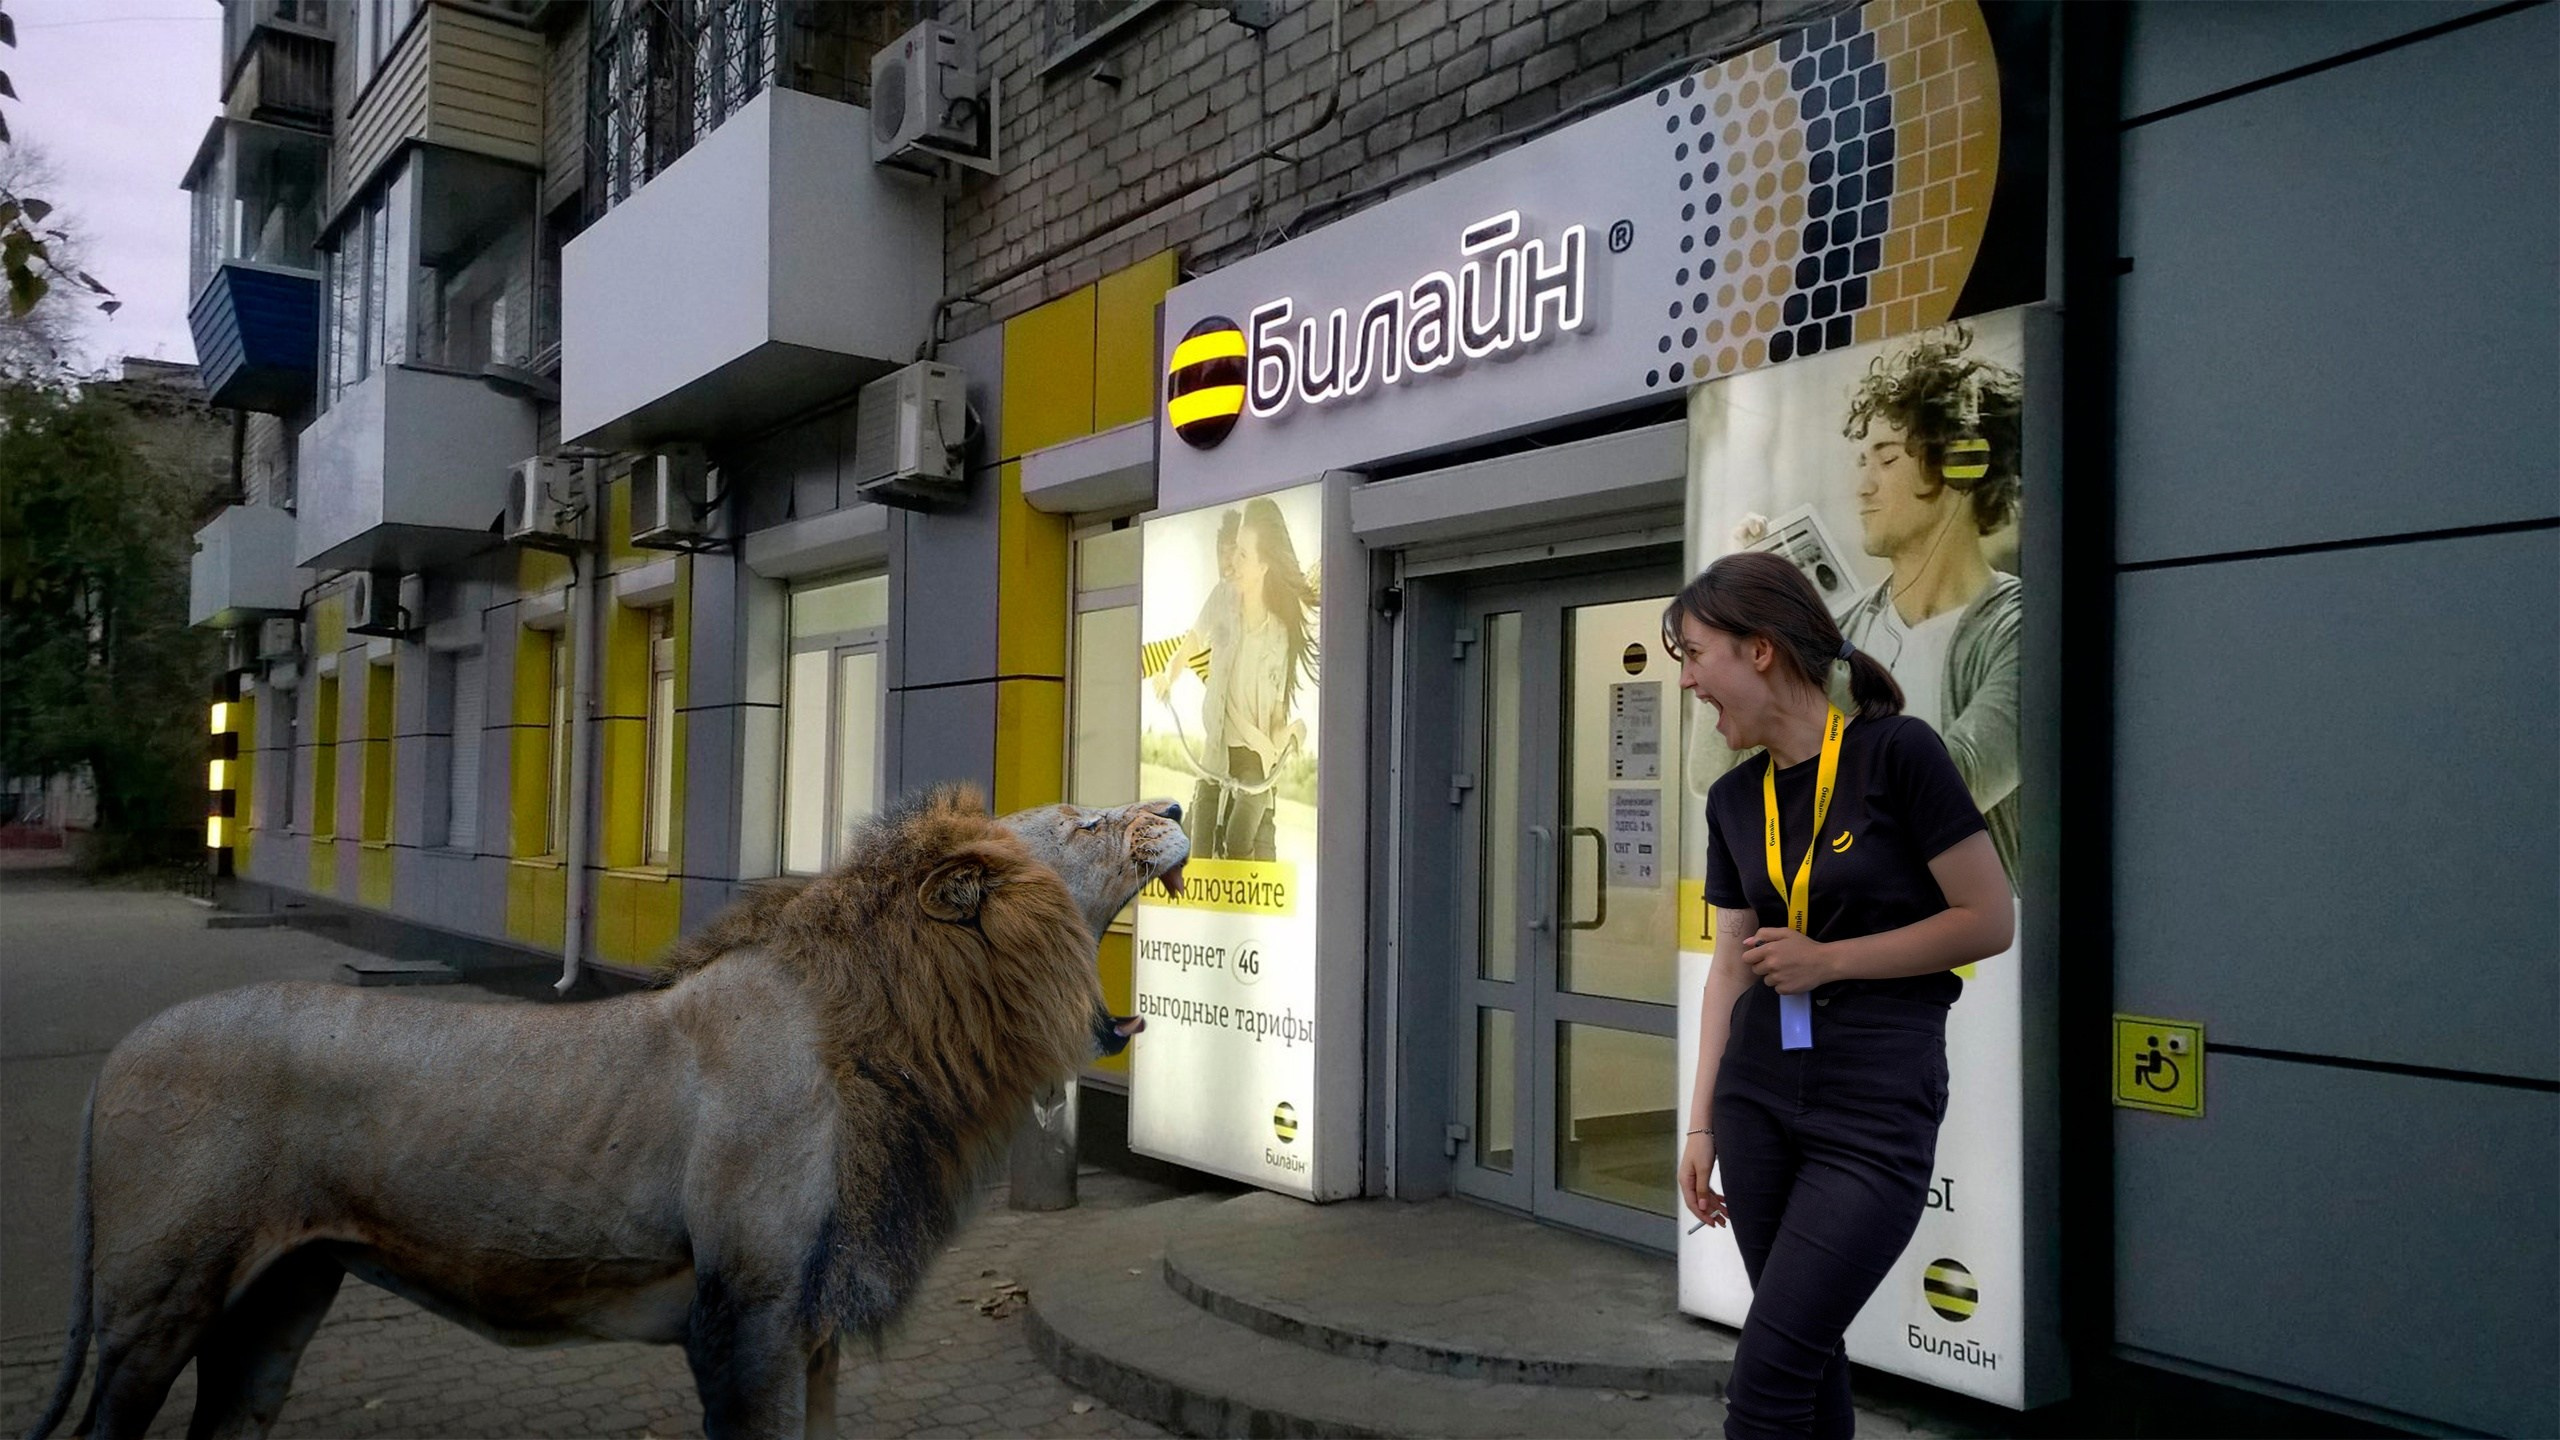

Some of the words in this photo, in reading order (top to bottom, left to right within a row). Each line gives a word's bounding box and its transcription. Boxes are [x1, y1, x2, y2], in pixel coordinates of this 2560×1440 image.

[1248, 209, 1587, 418] Билайн
[1829, 714, 1841, 742] билайн
[1141, 872, 1285, 908] оключайте
[1139, 939, 1226, 972] интернет
[1238, 950, 1260, 975] 4G
[1138, 993, 1229, 1028] выгодные
[1235, 1007, 1314, 1048] тарифы
[1265, 1148, 1305, 1174] Билайн
[1908, 1324, 1996, 1371] Билайн
